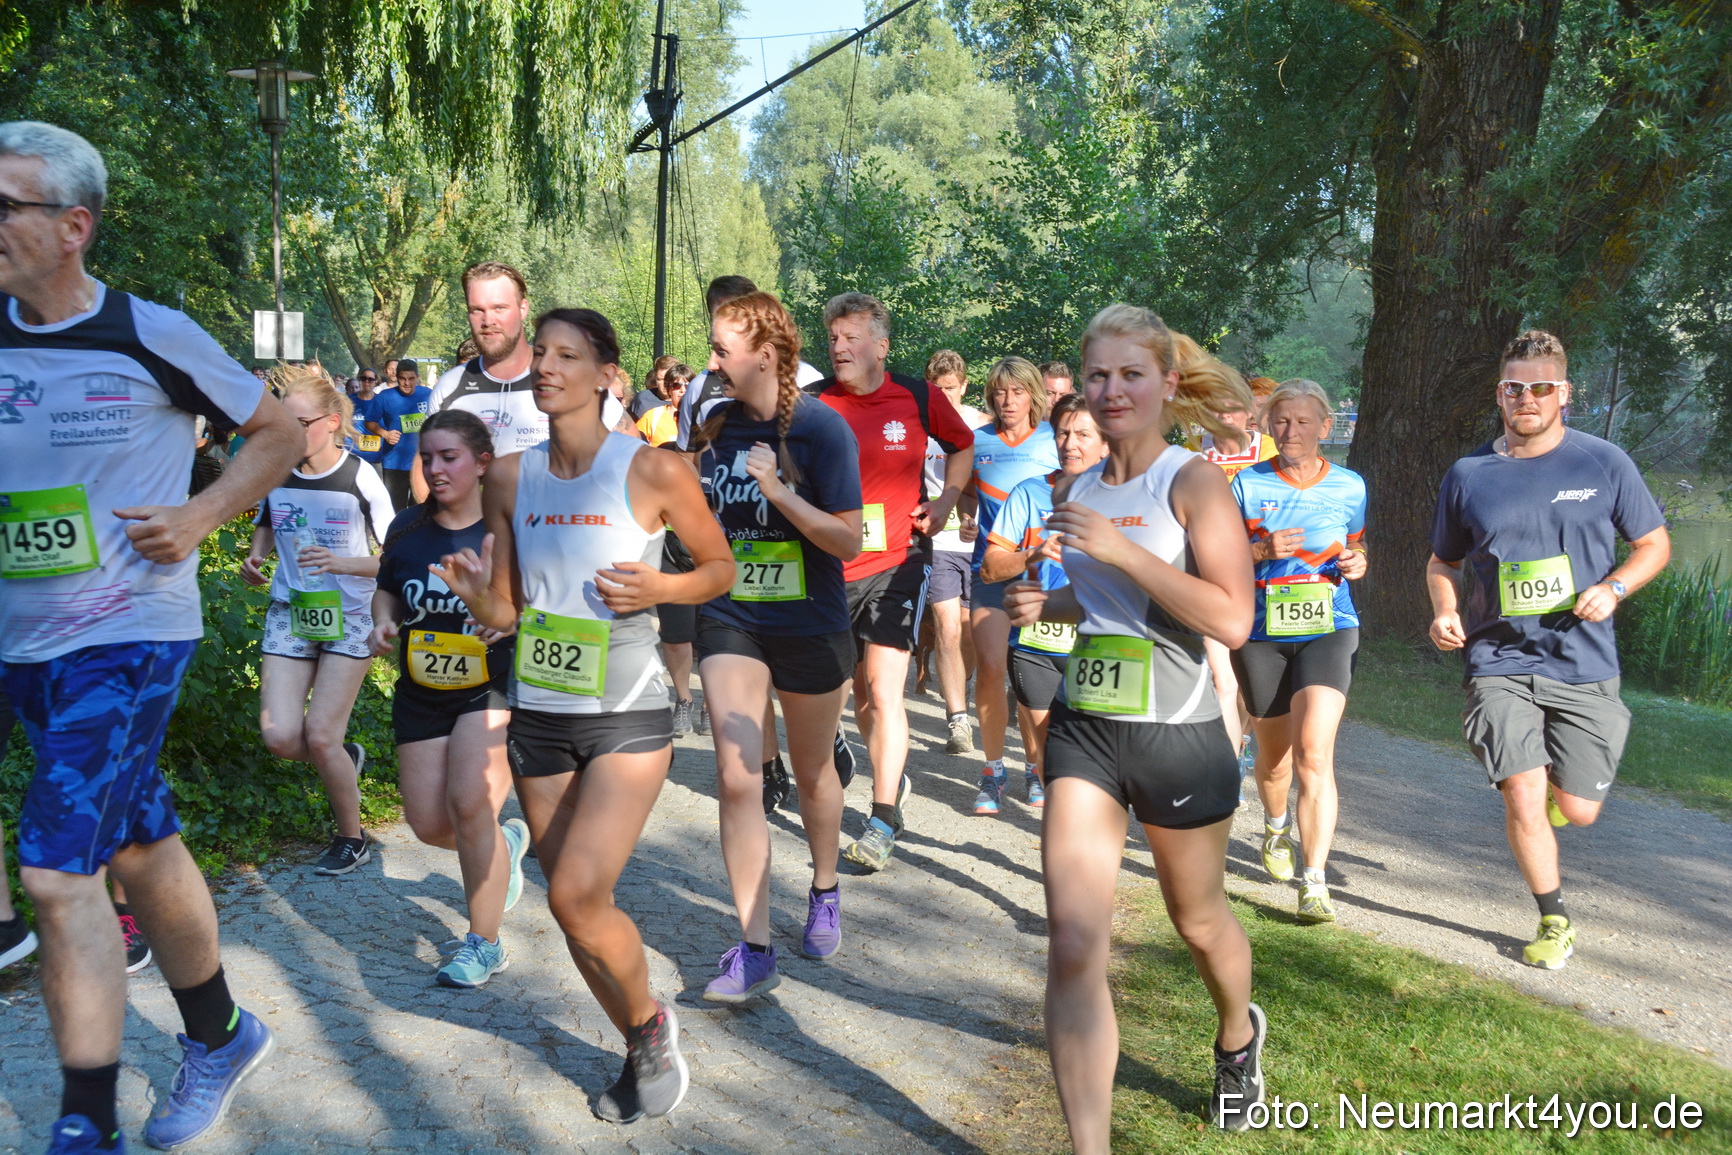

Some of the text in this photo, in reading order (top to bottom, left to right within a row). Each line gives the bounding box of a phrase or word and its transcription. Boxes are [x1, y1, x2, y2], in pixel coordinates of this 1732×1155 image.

[50, 408, 131, 424] VORSICHT!
[50, 425, 129, 440] Freilaufende
[884, 443, 907, 451] caritas
[545, 514, 612, 526] KLEBL
[0, 518, 77, 554] 1459
[743, 562, 784, 585] 277
[1509, 576, 1563, 600] 1094
[294, 608, 333, 627] 1480
[1276, 601, 1325, 621] 1584
[424, 653, 469, 676] 274
[532, 638, 582, 672] 882
[563, 671, 592, 682] Claudia
[1076, 658, 1121, 690] 881
[1100, 690, 1117, 699] Lisa
